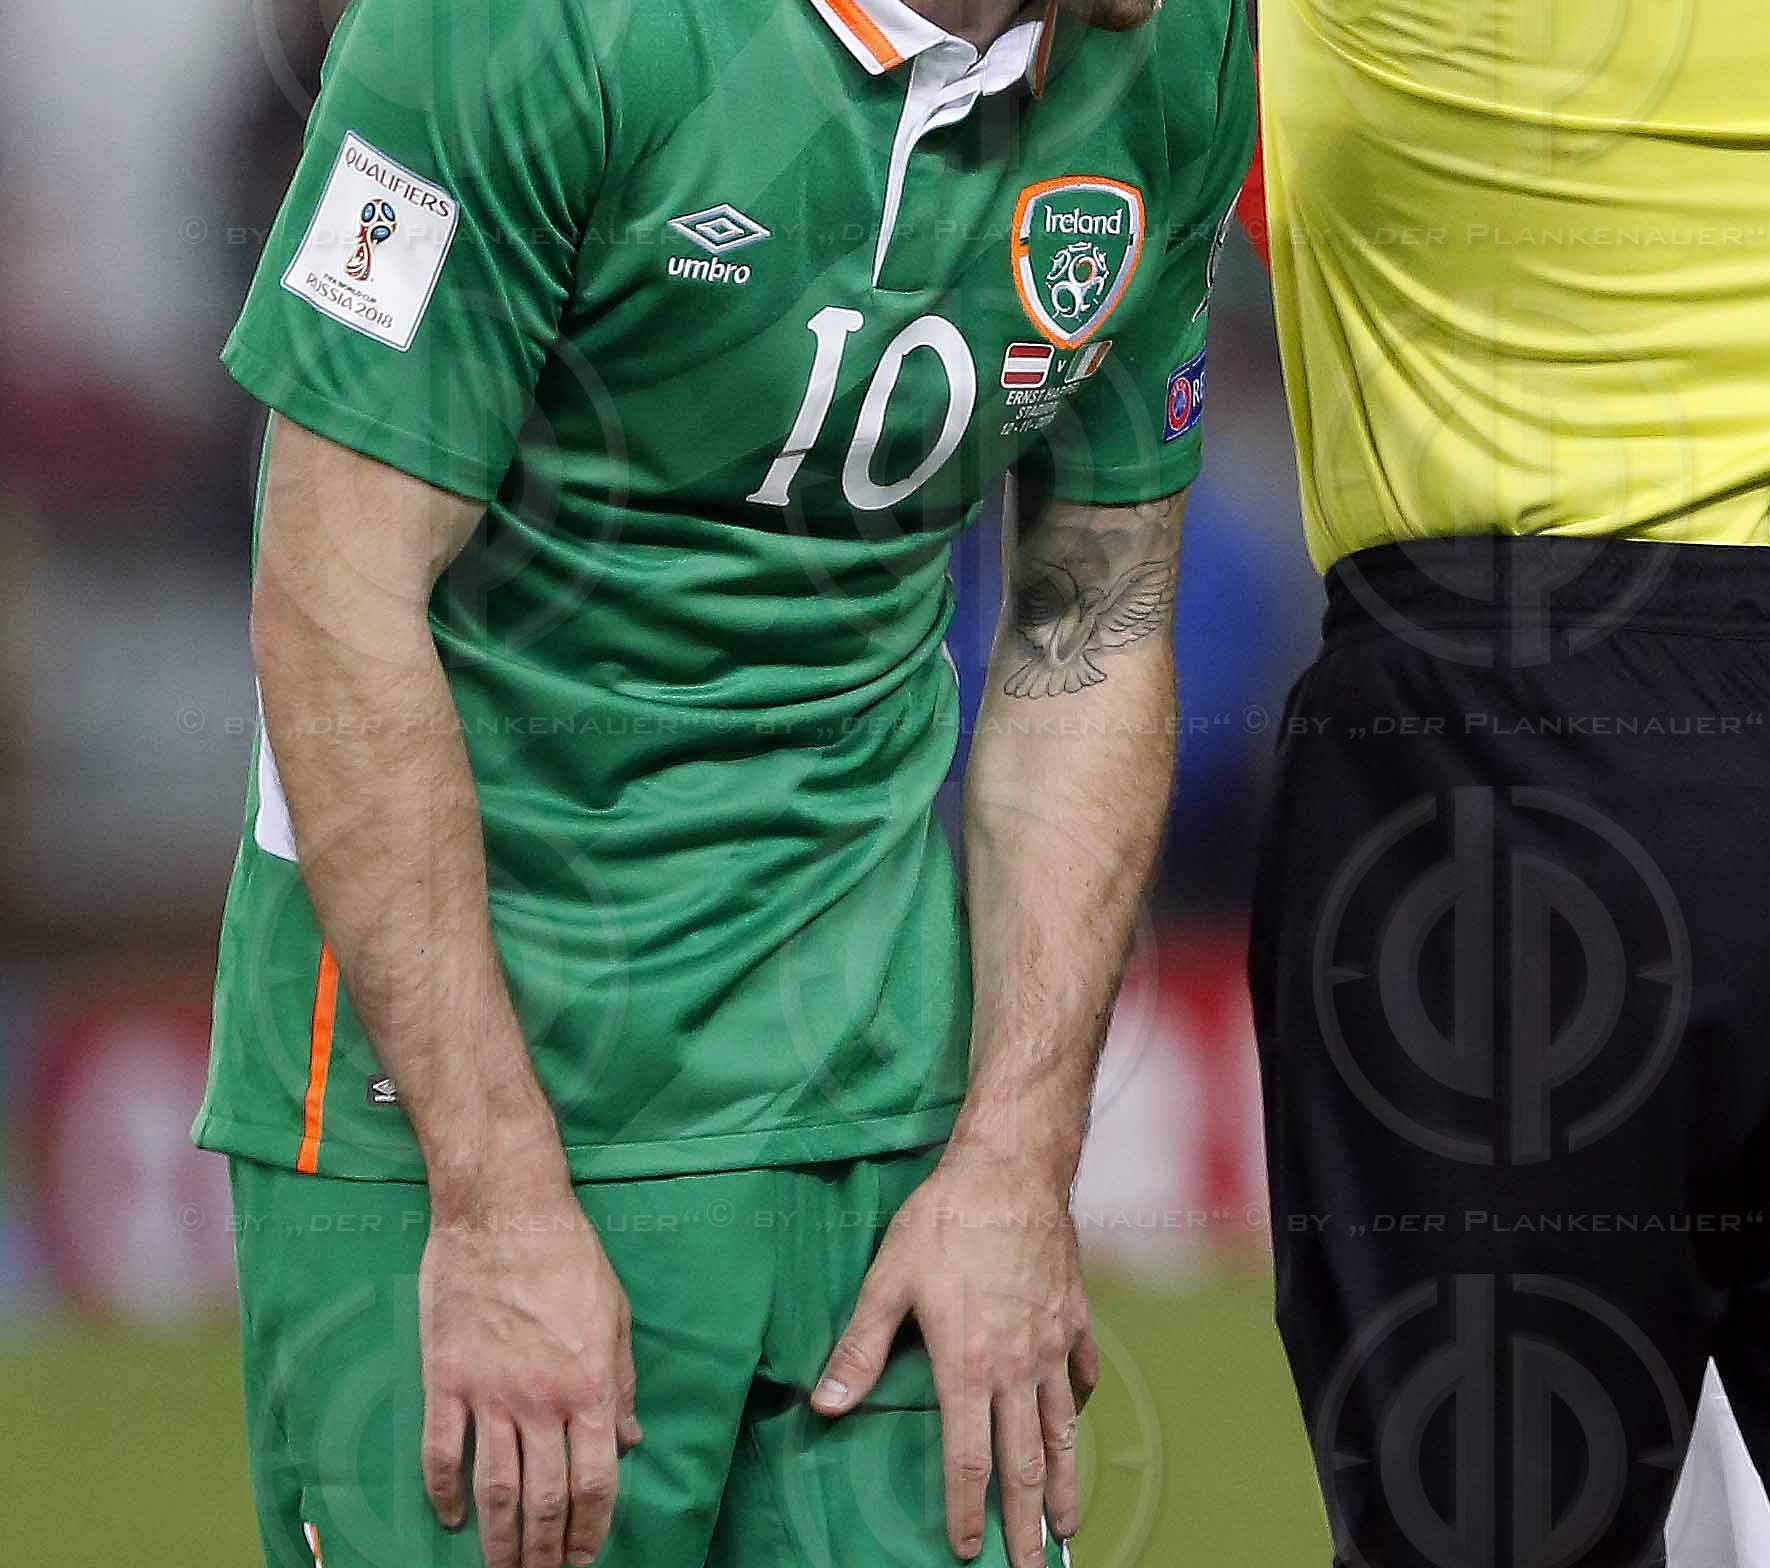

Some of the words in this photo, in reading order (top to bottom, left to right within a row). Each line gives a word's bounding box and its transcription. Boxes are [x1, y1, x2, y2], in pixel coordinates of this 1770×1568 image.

[344, 146, 450, 219] QUALIFIERS
[1044, 204, 1123, 235] Ireland
[667, 256, 752, 284] umbro
[304, 271, 354, 309] RUSSIA
[354, 300, 394, 330] 2018
[745, 304, 977, 511] 10
